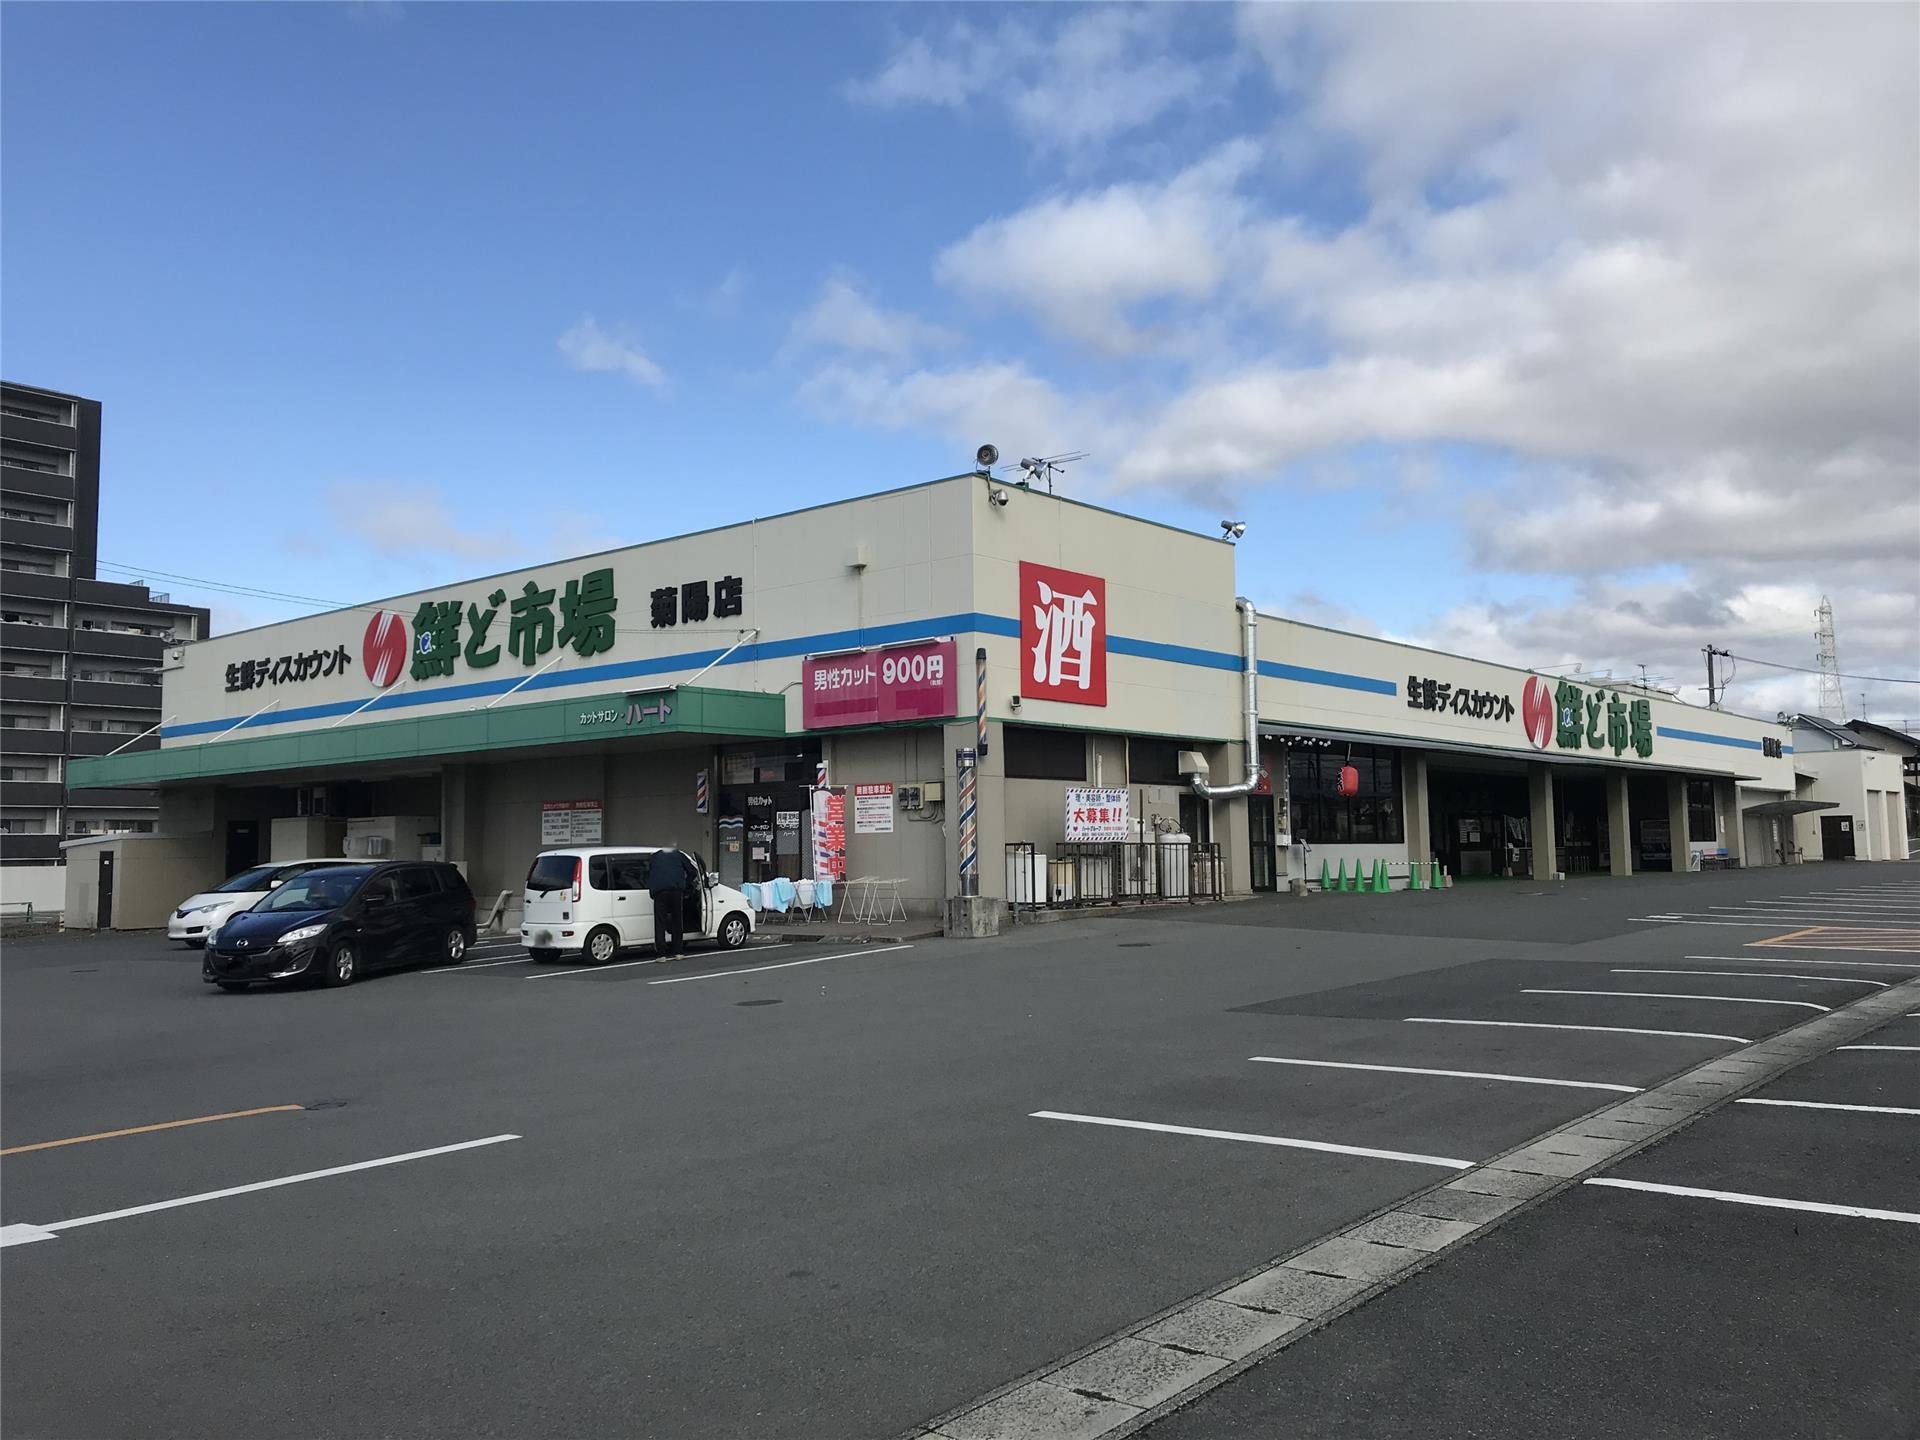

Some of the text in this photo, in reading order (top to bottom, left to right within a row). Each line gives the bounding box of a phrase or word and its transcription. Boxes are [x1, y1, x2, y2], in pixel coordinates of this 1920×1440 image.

[410, 567, 617, 681] 鮮ど市場
[650, 576, 743, 628] 菊陽店
[1031, 580, 1098, 689] 酒
[225, 645, 351, 692] 生鮮ディスカウント
[814, 654, 944, 691] 男性カット 900円
[1407, 675, 1515, 723] 生鮮ディスカウント
[1555, 681, 1653, 758] 鮮ど市場
[825, 794, 846, 880] 営業中
